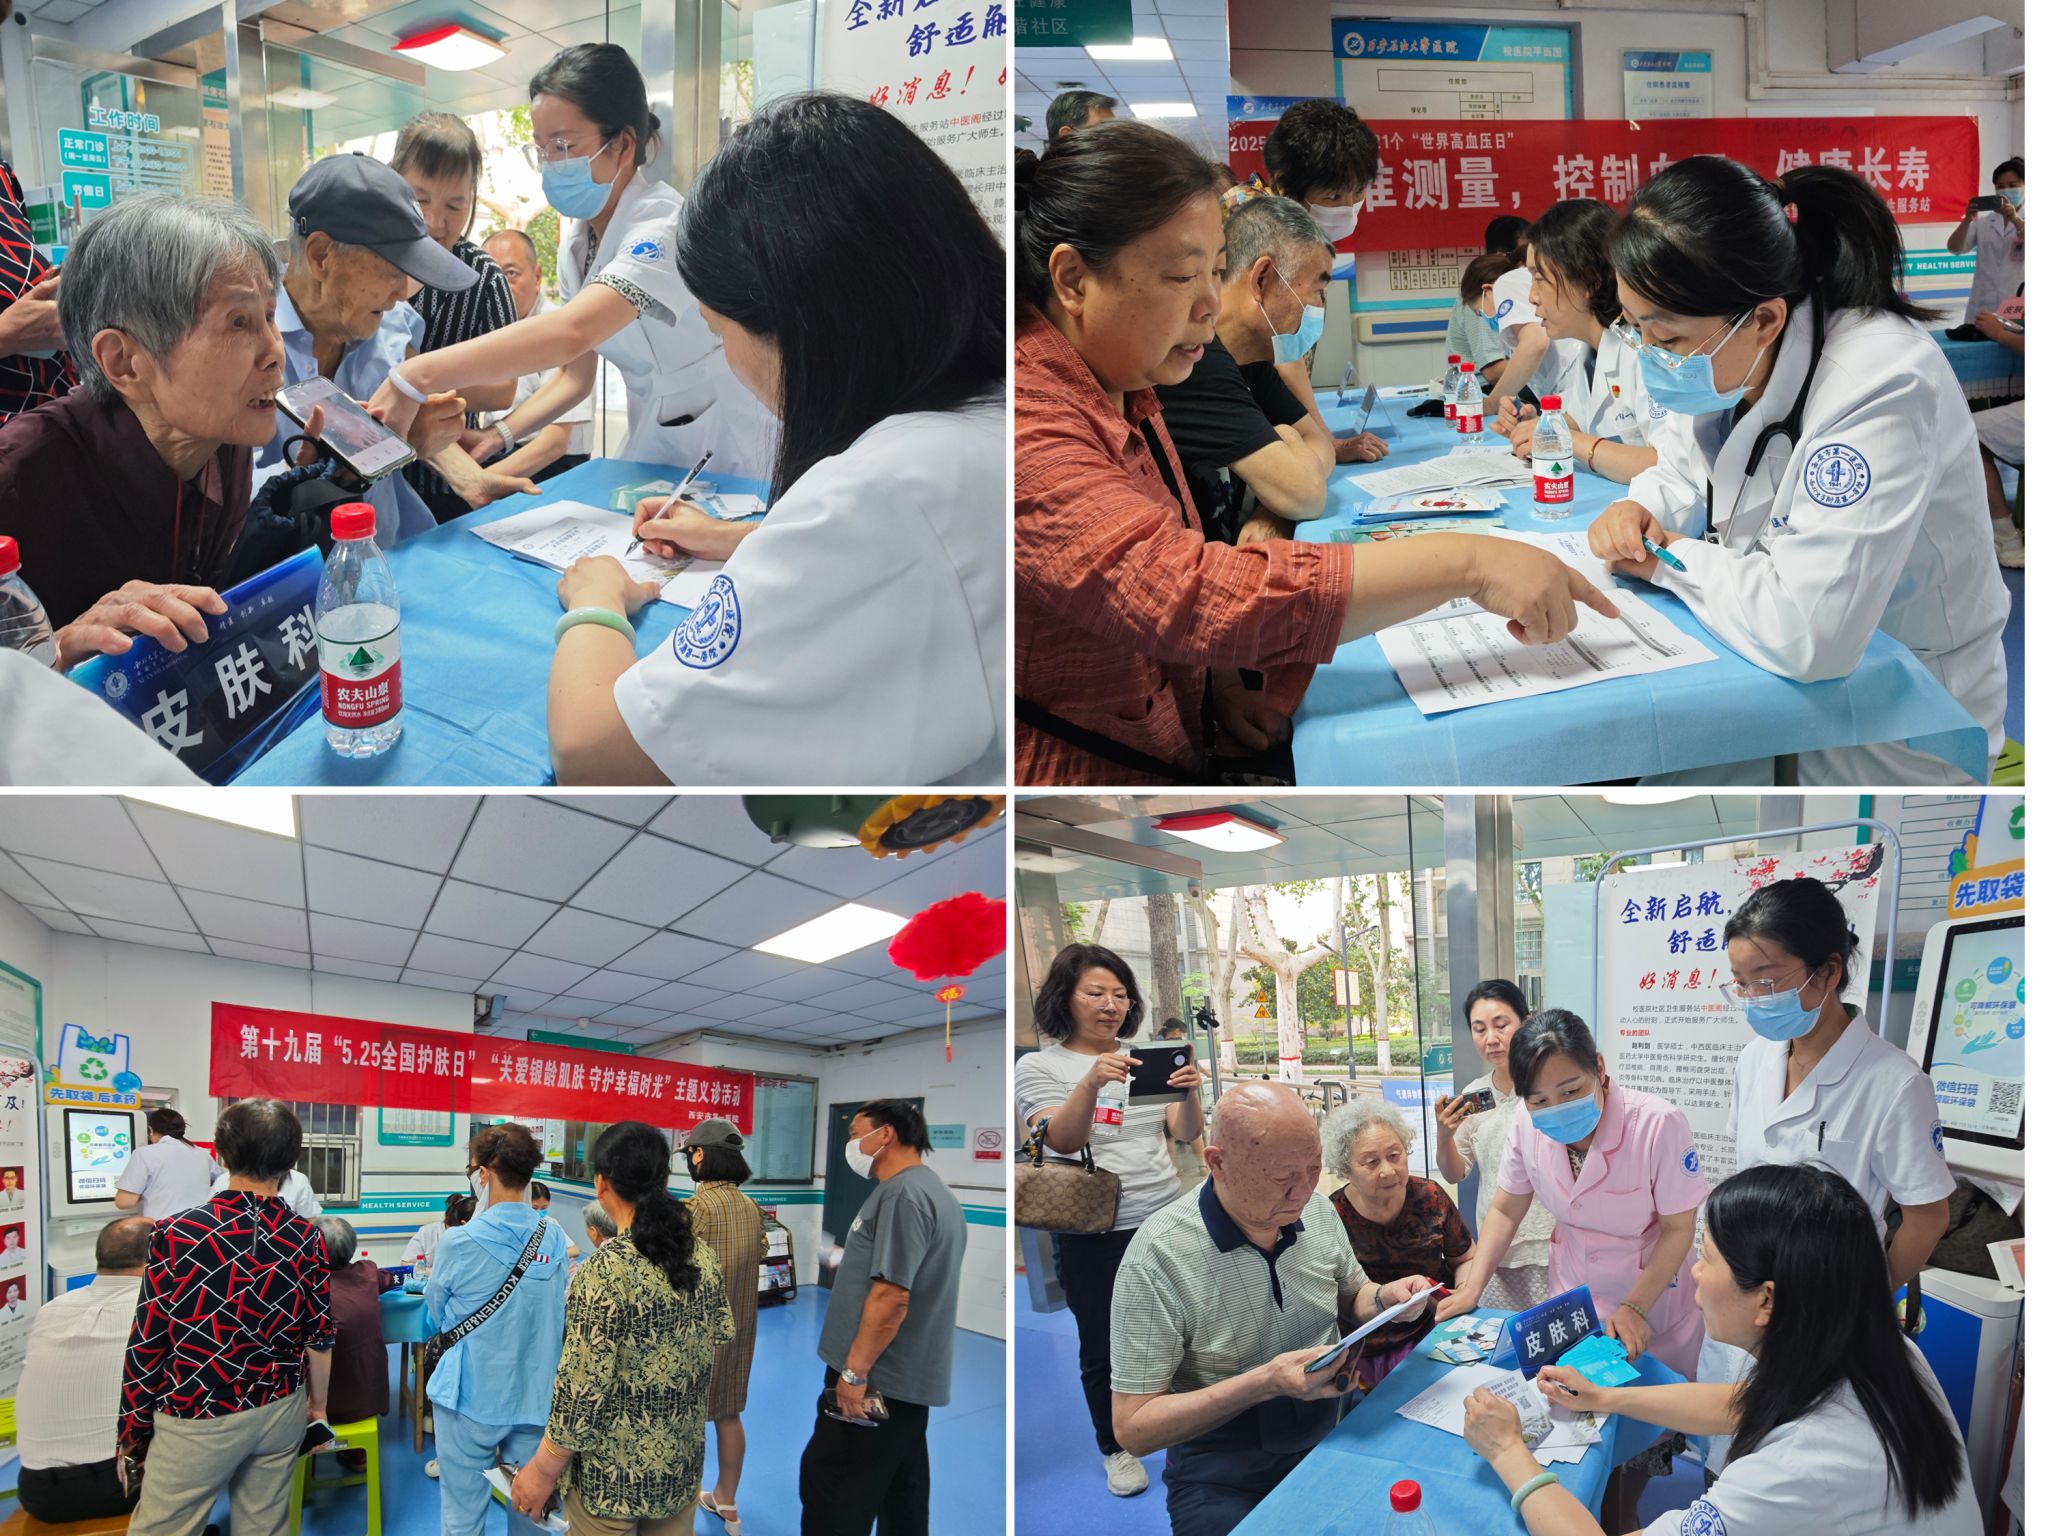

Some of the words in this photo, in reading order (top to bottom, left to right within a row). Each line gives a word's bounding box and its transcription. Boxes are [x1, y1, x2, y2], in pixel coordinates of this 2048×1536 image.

[845, 0, 938, 30] 全新
[90, 106, 160, 132] 工作时间
[911, 110, 1006, 133] 生服务站中医阁经过
[64, 137, 104, 152] 正常门诊
[1412, 132, 1514, 150] “世界高血压日”
[72, 184, 104, 197] 节假日
[1916, 261, 1949, 270] HEALTH
[337, 681, 389, 702] 农夫山泉
[338, 701, 364, 710] NONGFU
[366, 695, 389, 709] SPRING
[1620, 891, 1732, 924] 全新启航，
[1667, 928, 1730, 954] 舒适
[1639, 968, 1717, 990] 好消息！
[240, 1024, 322, 1064] 第十九届
[674, 1078, 741, 1107] 主题义诊活动
[50, 1088, 94, 1102] 先取袋
[98, 1093, 136, 1104] 后拿药
[1935, 1080, 1979, 1096] 微信扫码
[1525, 1307, 1590, 1358] 皮肤科
